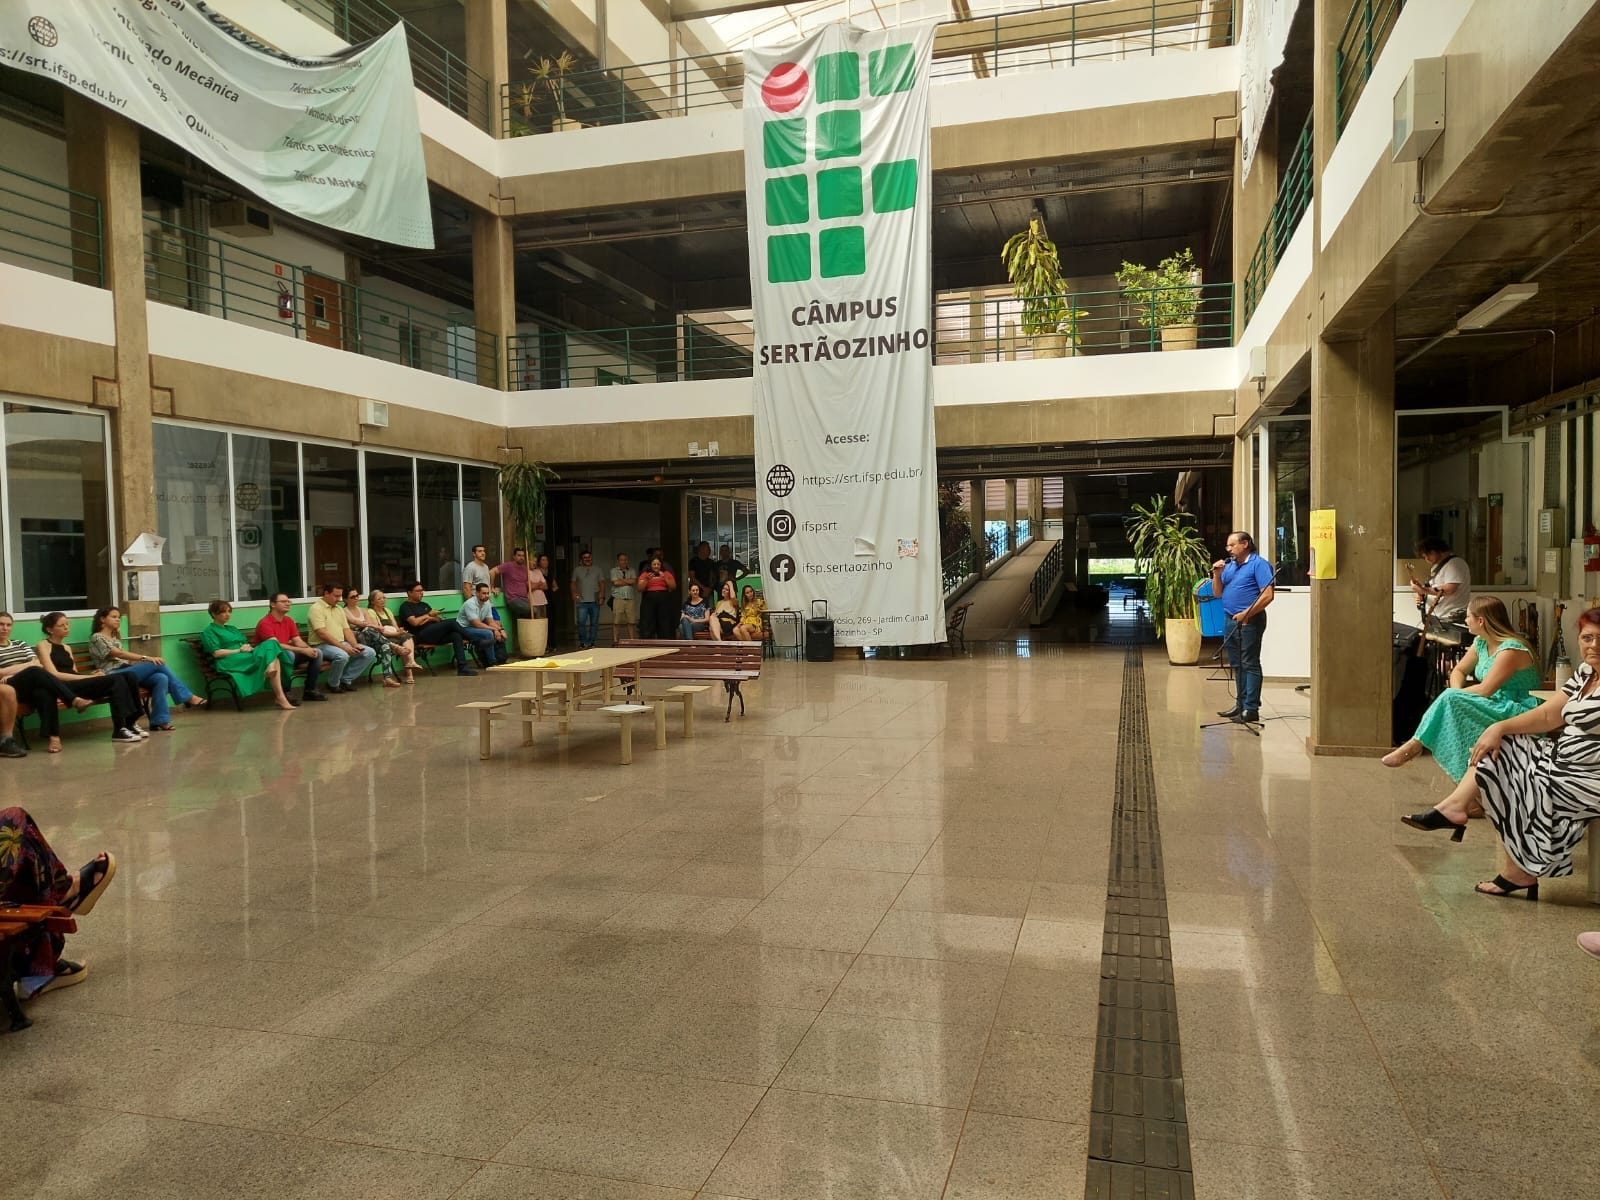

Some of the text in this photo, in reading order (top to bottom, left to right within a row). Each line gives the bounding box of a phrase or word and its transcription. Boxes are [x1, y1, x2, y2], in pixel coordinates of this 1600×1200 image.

[174, 60, 240, 103] Mecânica
[791, 296, 898, 327] CÂMPUS
[760, 328, 929, 366] SERTÃOZINHO
[824, 433, 870, 445] Acesse:
[802, 467, 924, 488] https://srt.ifsp.edu.br/
[801, 520, 838, 534] ifspsrt
[802, 560, 893, 576] ifsp.sertaozinho
[857, 616, 872, 625] 269
[878, 615, 903, 625] Jardim
[872, 627, 883, 636] SP
